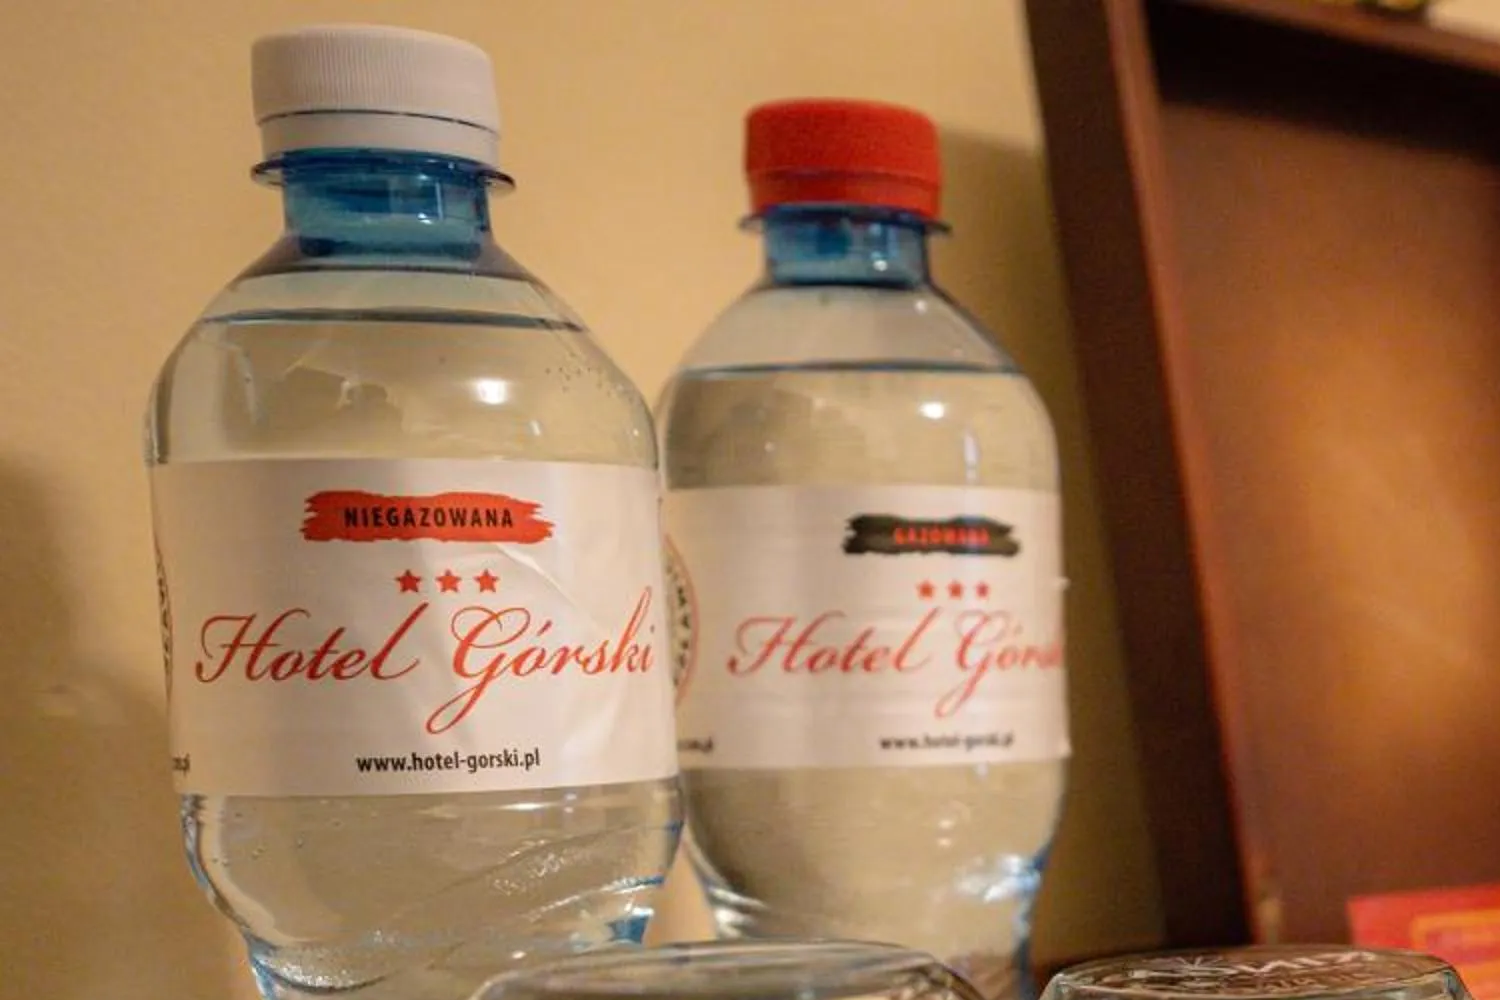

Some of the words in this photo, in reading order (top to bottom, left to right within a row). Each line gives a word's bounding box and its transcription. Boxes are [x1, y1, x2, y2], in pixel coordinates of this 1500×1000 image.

[343, 505, 515, 529] NIEGAZOWANA
[194, 601, 429, 683] Hotel
[425, 585, 655, 735] Górski
[726, 606, 943, 677] Hotel
[356, 748, 541, 774] www.hotel-gorski.pl
